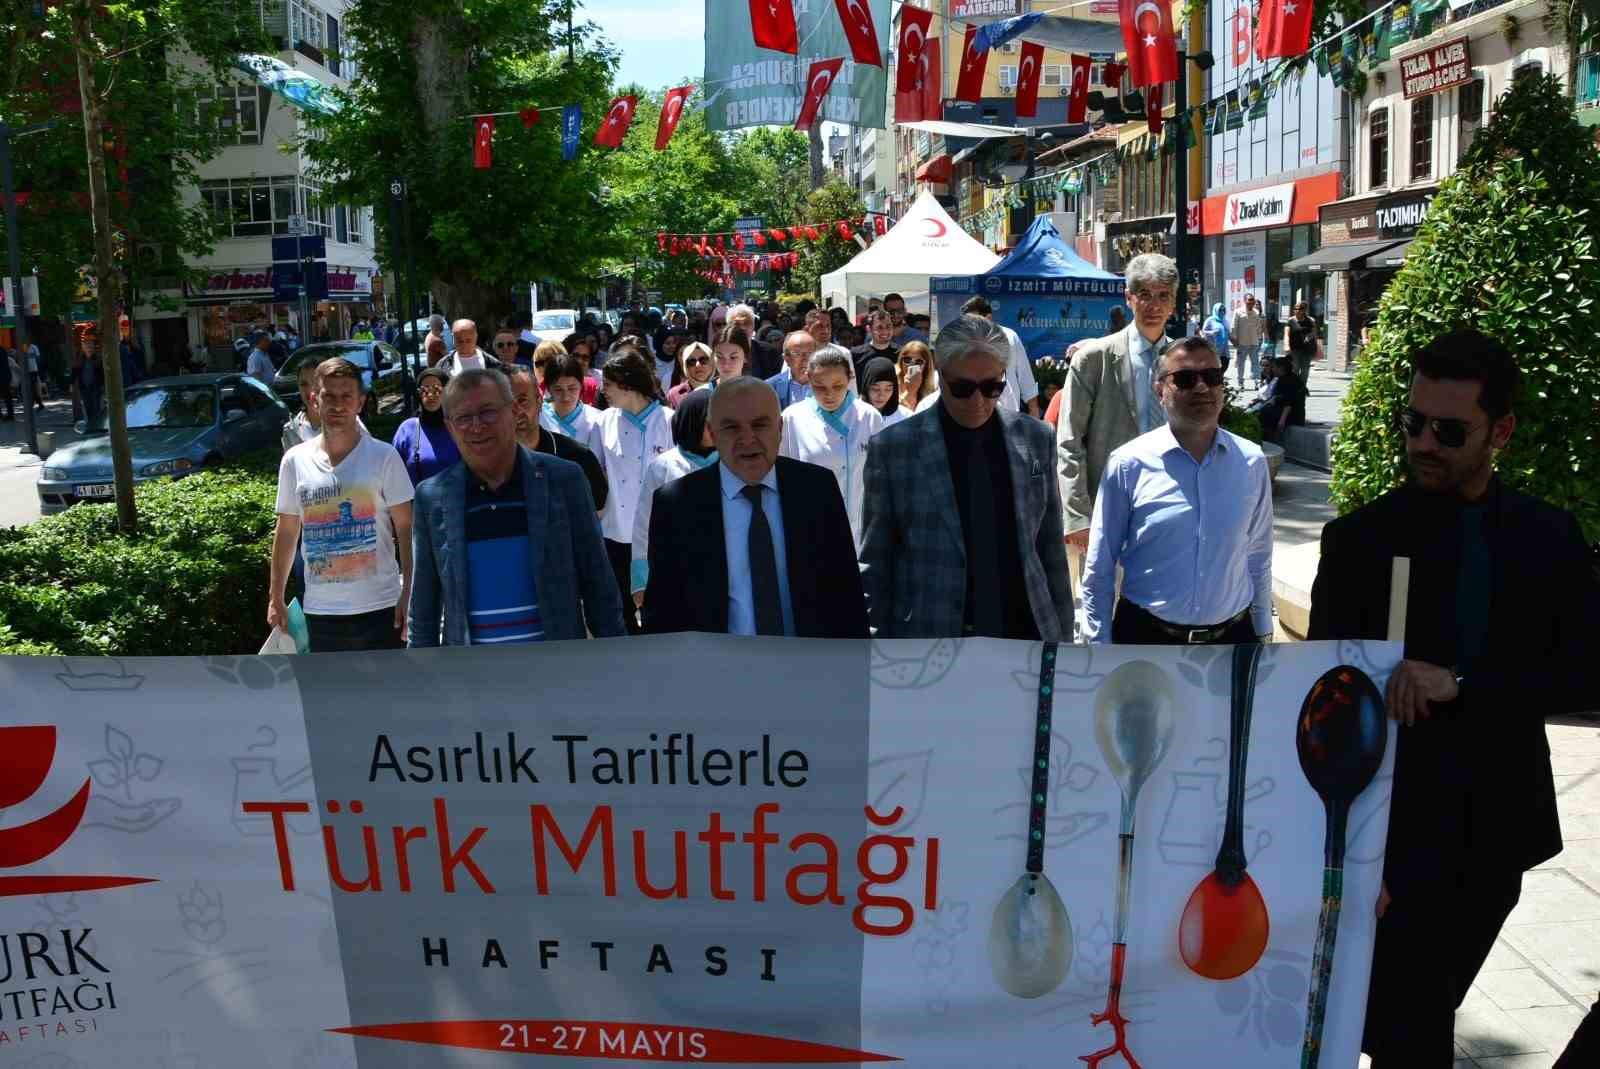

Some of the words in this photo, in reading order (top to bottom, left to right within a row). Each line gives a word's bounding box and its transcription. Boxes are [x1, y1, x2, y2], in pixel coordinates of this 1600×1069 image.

[368, 732, 538, 784] Asırlık
[552, 733, 809, 787] Tariflerle
[241, 797, 497, 894] Türk
[529, 802, 940, 937] Mutfağı
[421, 937, 777, 982] HAFTASI
[499, 1023, 587, 1051] 21-27
[600, 1030, 708, 1059] MAYIS
